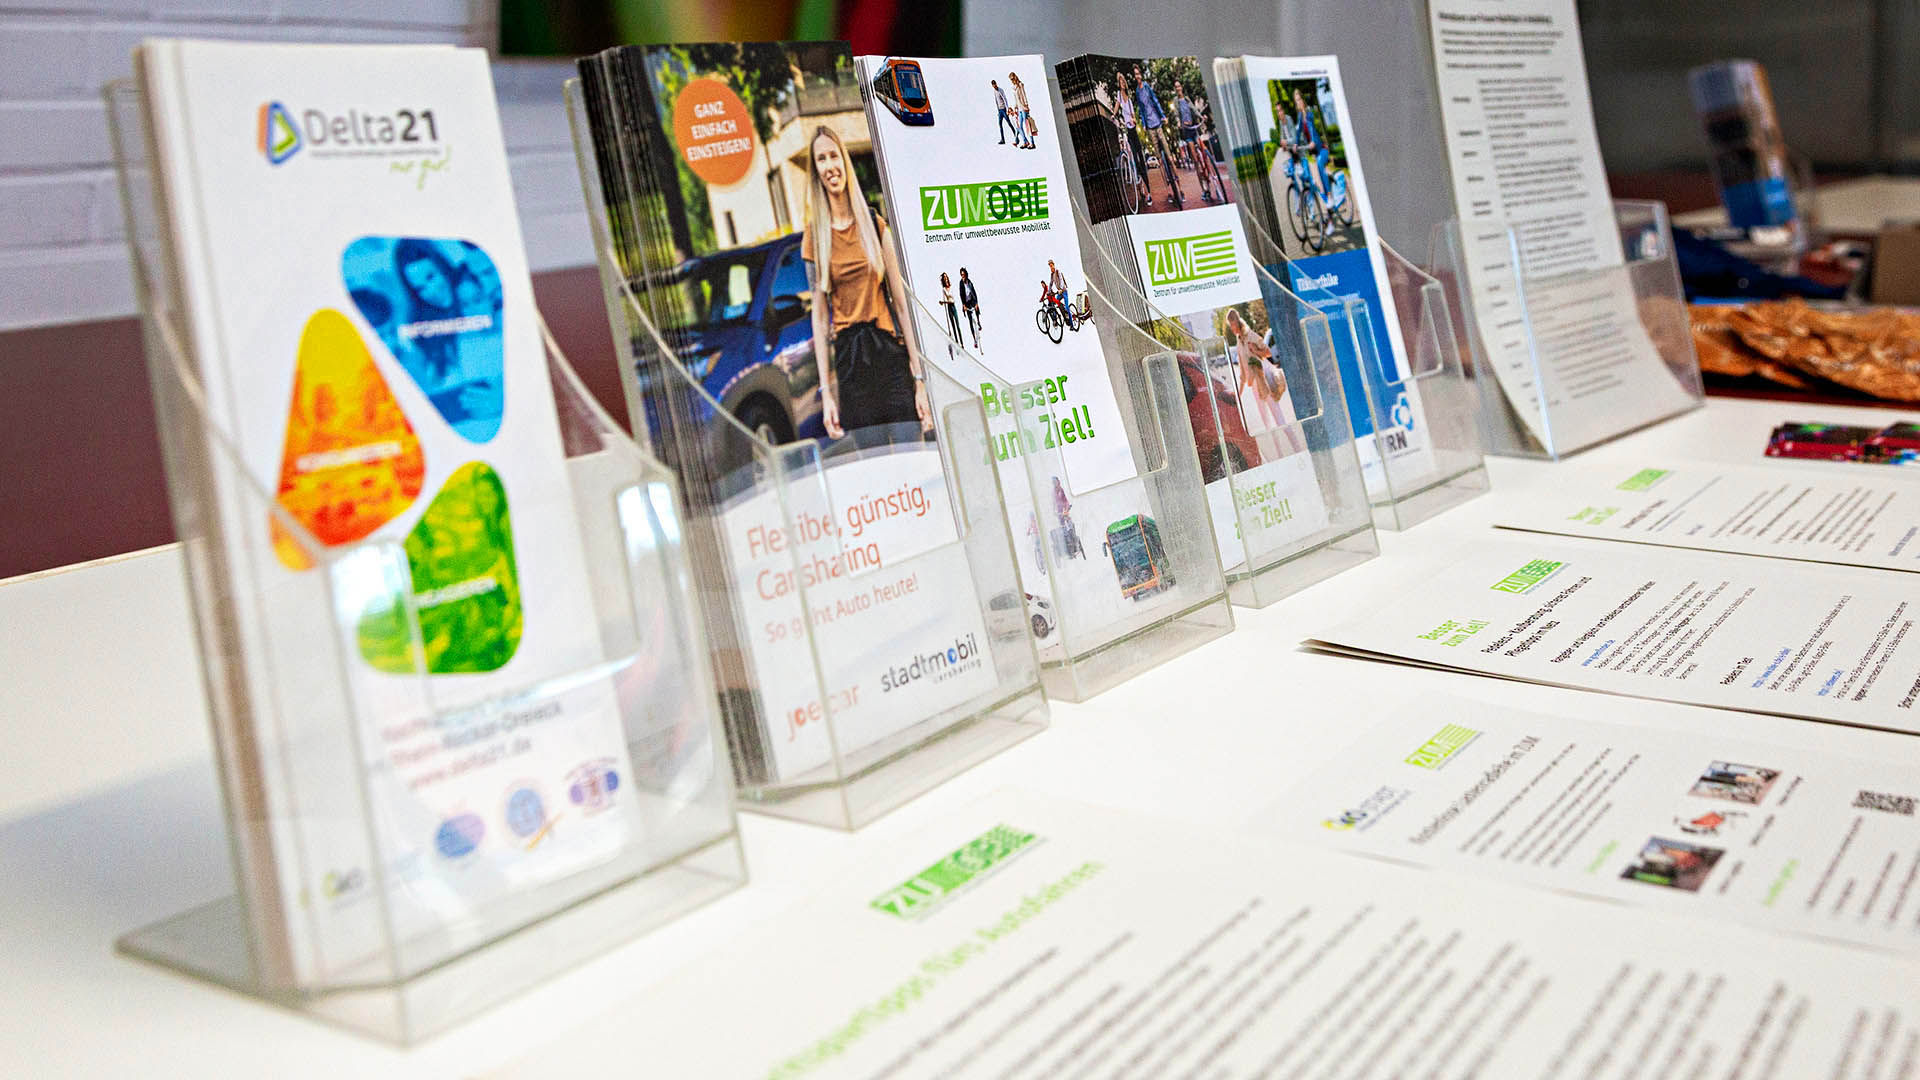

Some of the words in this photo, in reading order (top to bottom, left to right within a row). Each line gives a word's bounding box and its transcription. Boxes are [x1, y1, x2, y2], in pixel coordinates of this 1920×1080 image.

[303, 108, 438, 145] Delta21
[691, 119, 738, 139] EINFACH
[694, 101, 726, 119] GANZ
[686, 137, 752, 161] EINSTEIGEN!
[923, 181, 1049, 227] ZUMOBIL
[925, 232, 953, 244] Zentrum
[953, 229, 964, 240] für
[964, 224, 1020, 240] umweltbewusste
[1021, 221, 1051, 233] Mobilität
[1148, 240, 1197, 282] ZUM
[980, 374, 1068, 418] Besser
[978, 430, 1037, 465] um
[1038, 404, 1095, 450] Ziel!
[1236, 481, 1276, 510] esser
[747, 512, 843, 560] Flexibe,
[847, 481, 931, 537] günstig,
[756, 541, 882, 600] Carshaing
[765, 620, 787, 643] So
[790, 604, 834, 640] ght
[835, 592, 871, 620] Auto
[871, 570, 920, 606] heute!
[880, 632, 978, 693] stadtmobil
